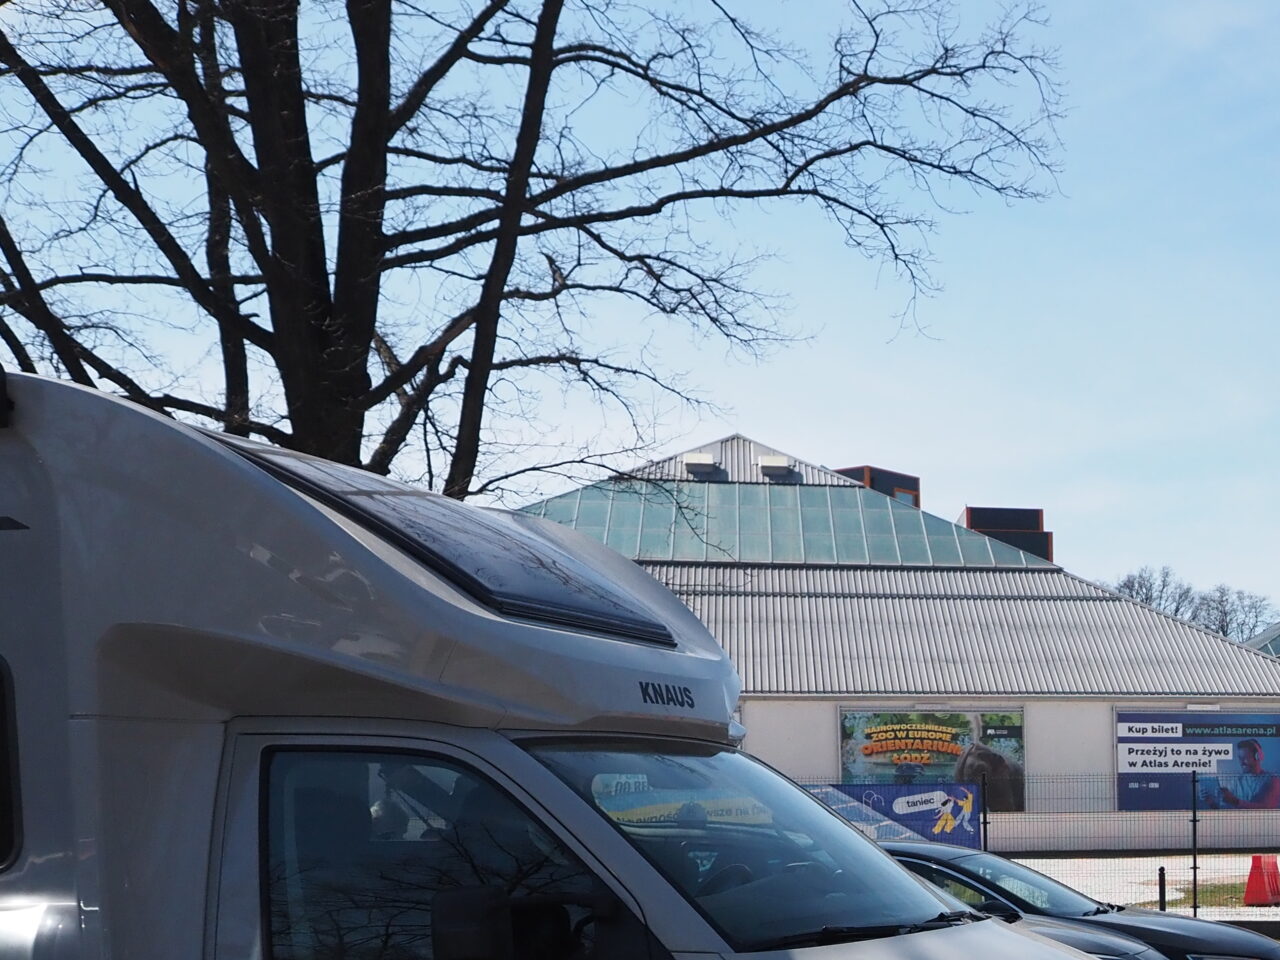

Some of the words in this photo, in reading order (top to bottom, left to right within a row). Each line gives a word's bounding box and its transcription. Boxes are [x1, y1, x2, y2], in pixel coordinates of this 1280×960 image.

[639, 681, 695, 709] KNAUS
[871, 731, 895, 741] ZOO
[896, 730, 908, 738] W
[909, 731, 953, 741] EUROPIE
[1127, 725, 1148, 735] Kup
[1151, 725, 1178, 734] bilet!
[1186, 726, 1276, 735] www.atlasarena.pl
[861, 740, 962, 754] ORIENTARIUM
[1128, 747, 1168, 757] Przeżyj
[1171, 748, 1182, 756] to
[1202, 747, 1230, 757] żywo
[892, 750, 931, 764] ŁÓDŹ
[906, 796, 935, 808] taniec
